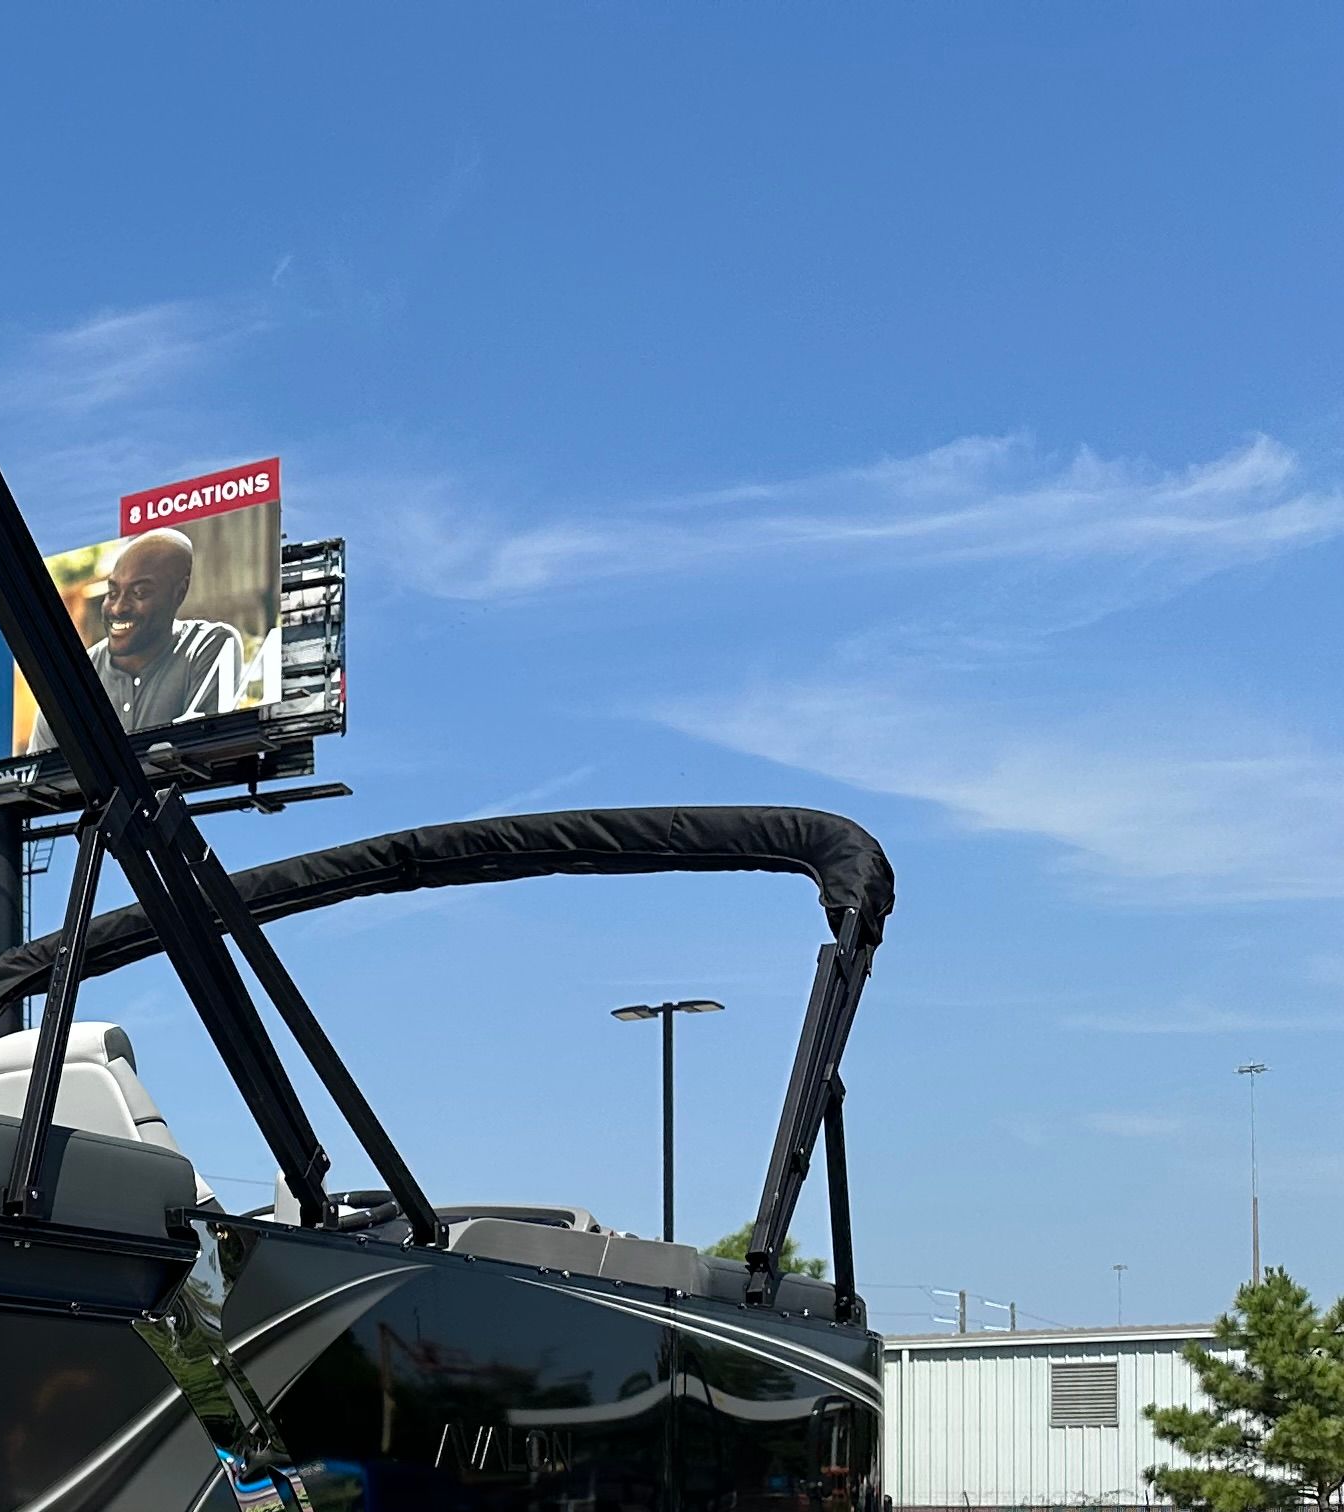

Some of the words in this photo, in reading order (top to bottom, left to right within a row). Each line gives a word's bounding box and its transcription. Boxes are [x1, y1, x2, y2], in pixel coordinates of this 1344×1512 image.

[129, 506, 141, 524] 8
[147, 473, 270, 520] LOCATIONS
[434, 1424, 573, 1472] AVALON
